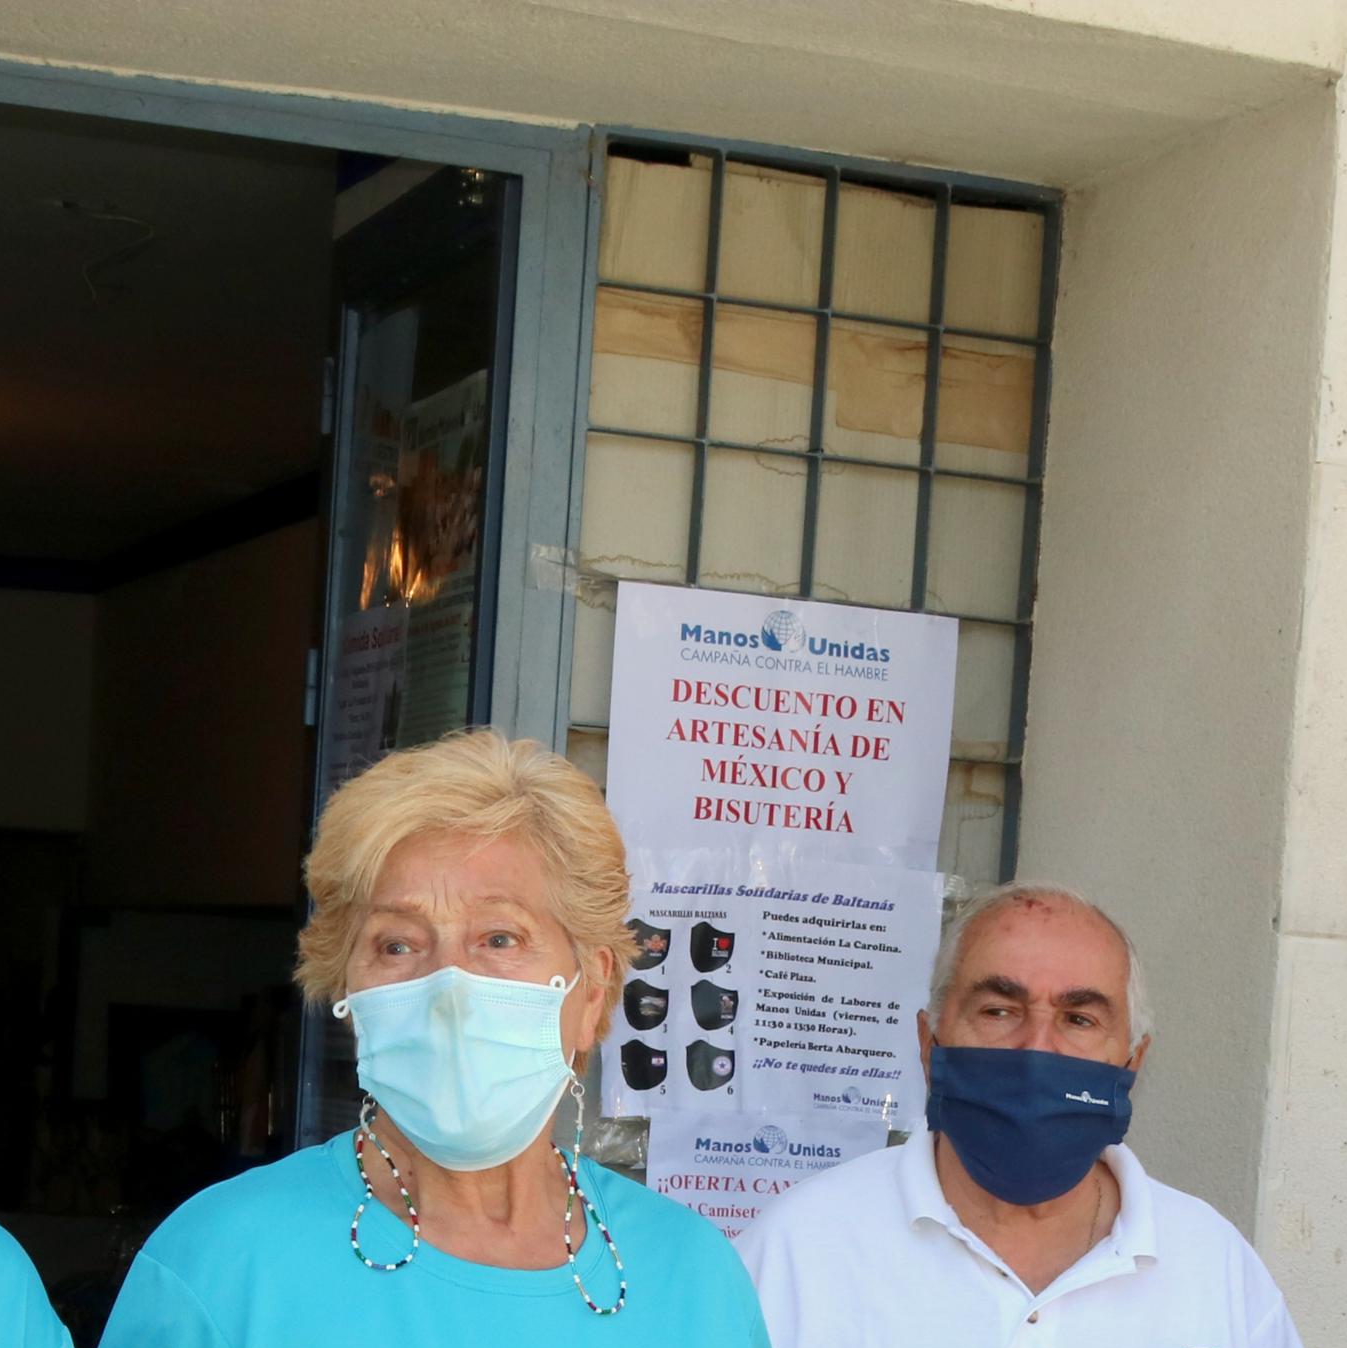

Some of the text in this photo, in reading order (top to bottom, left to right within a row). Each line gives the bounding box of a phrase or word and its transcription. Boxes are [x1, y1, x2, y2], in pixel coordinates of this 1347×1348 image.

[681, 623, 890, 662] Manos Unidas
[681, 648, 889, 681] CAMPAÑA CONTRA EL HAMBRE
[671, 679, 906, 724] DESCUENTO EN
[666, 718, 890, 761] ARTESANÍA DE
[701, 755, 854, 795] MÉXICO Y
[693, 796, 855, 834] BISUTERÍA
[651, 883, 895, 911] Mascarillas de Baltanás
[763, 911, 887, 933] Puedes adquirirlas en:
[839, 937, 902, 953] La Carolina.
[817, 955, 873, 970] Municipal.
[790, 972, 816, 983] Plaza.
[822, 993, 900, 1010] de Labores de
[756, 1004, 898, 1024] Manos Unidas (viernes, de
[818, 1024, 857, 1036] Horas).
[808, 1042, 897, 1058] Berta Abarquero.
[786, 1060, 858, 1076] te quedes sin
[695, 1137, 840, 1157] Manos Unidas
[694, 1154, 804, 1169] CAMPAÑA CONTRA EL
[658, 1174, 745, 1194] ¡¡OFERTA
